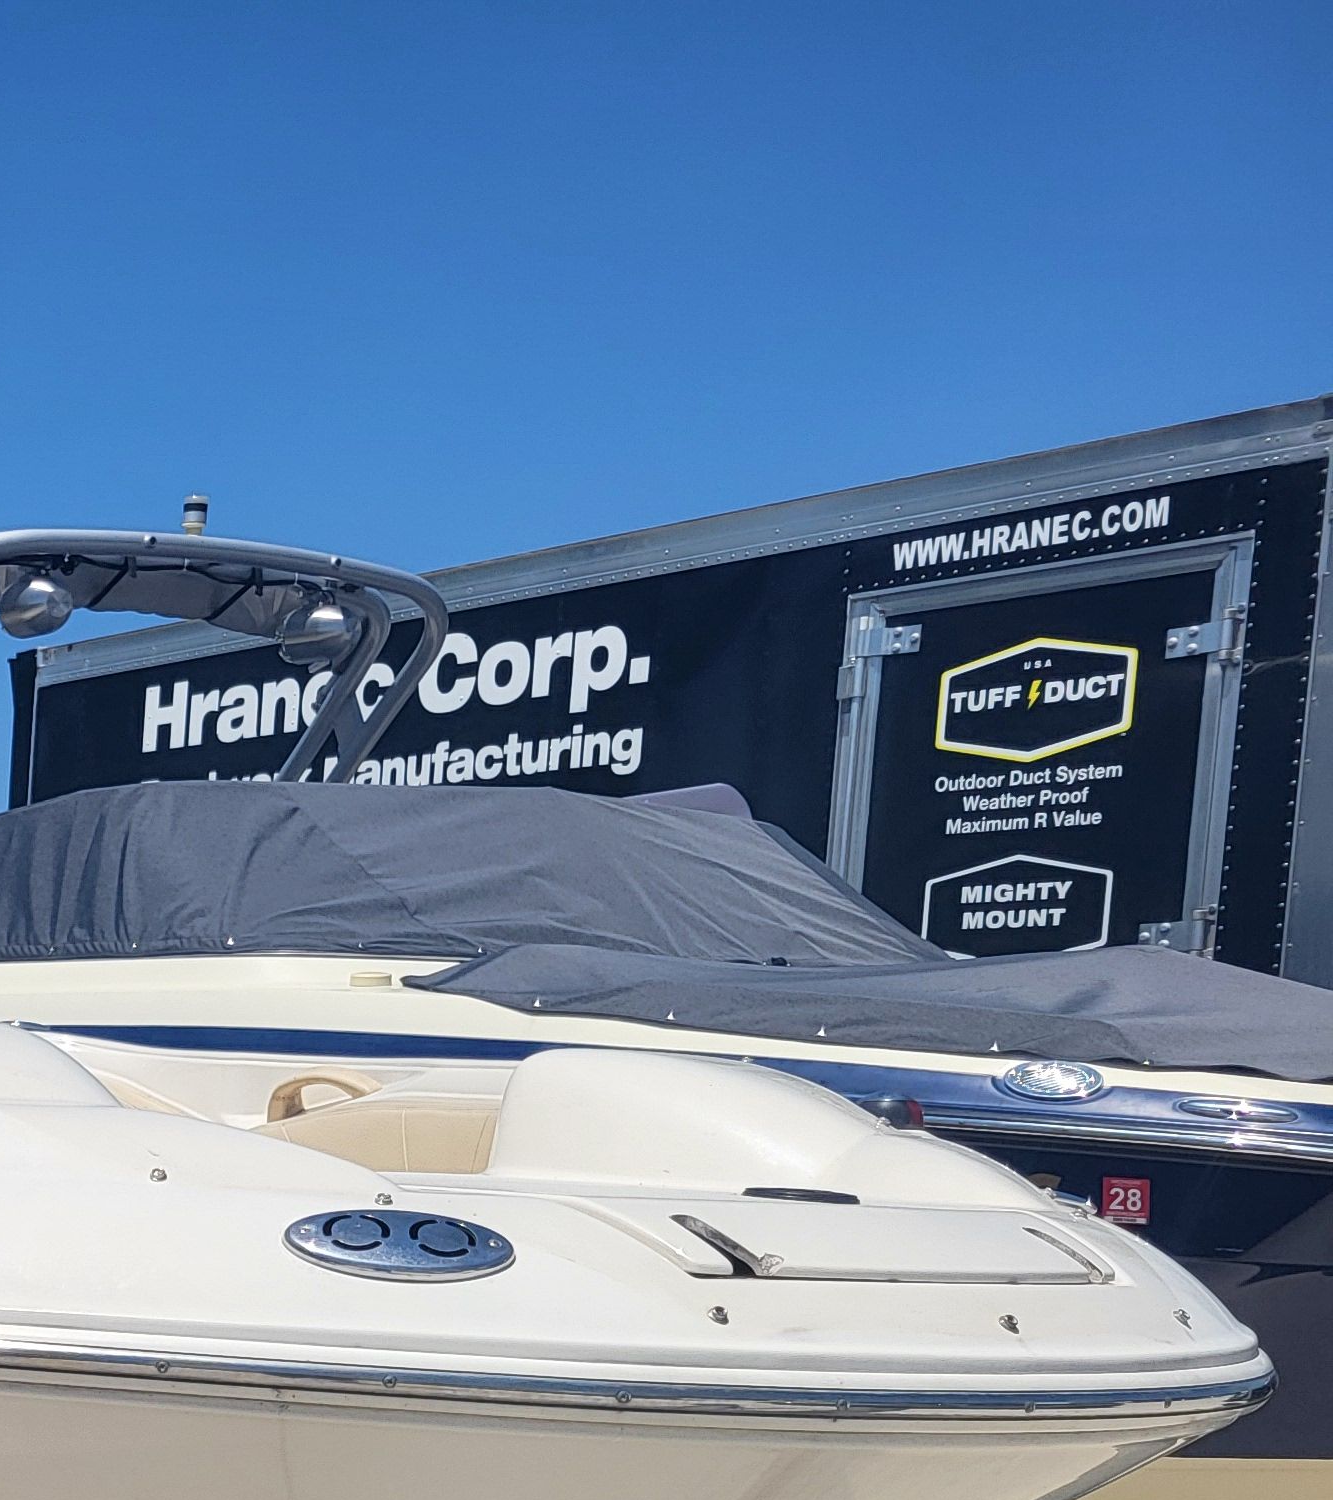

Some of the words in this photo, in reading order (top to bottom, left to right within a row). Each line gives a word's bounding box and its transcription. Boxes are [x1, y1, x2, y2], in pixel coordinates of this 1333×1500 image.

[893, 496, 1170, 571] WWW.HRANEC.COM
[417, 625, 650, 714] Corp.
[950, 684, 1022, 713] TUFF
[1043, 673, 1124, 704] DUCT
[934, 774, 1005, 792] Outdoor
[1009, 768, 1051, 786] Duct
[1055, 765, 1123, 784] System
[963, 795, 1035, 812] Weather
[1039, 787, 1089, 806] Proof
[945, 817, 1028, 835] Maximum
[1034, 812, 1048, 828] R
[1053, 810, 1102, 827] Value
[960, 880, 1073, 904] MIGHTY
[961, 908, 1067, 930] MOUNT
[1108, 1187, 1142, 1211] 28
